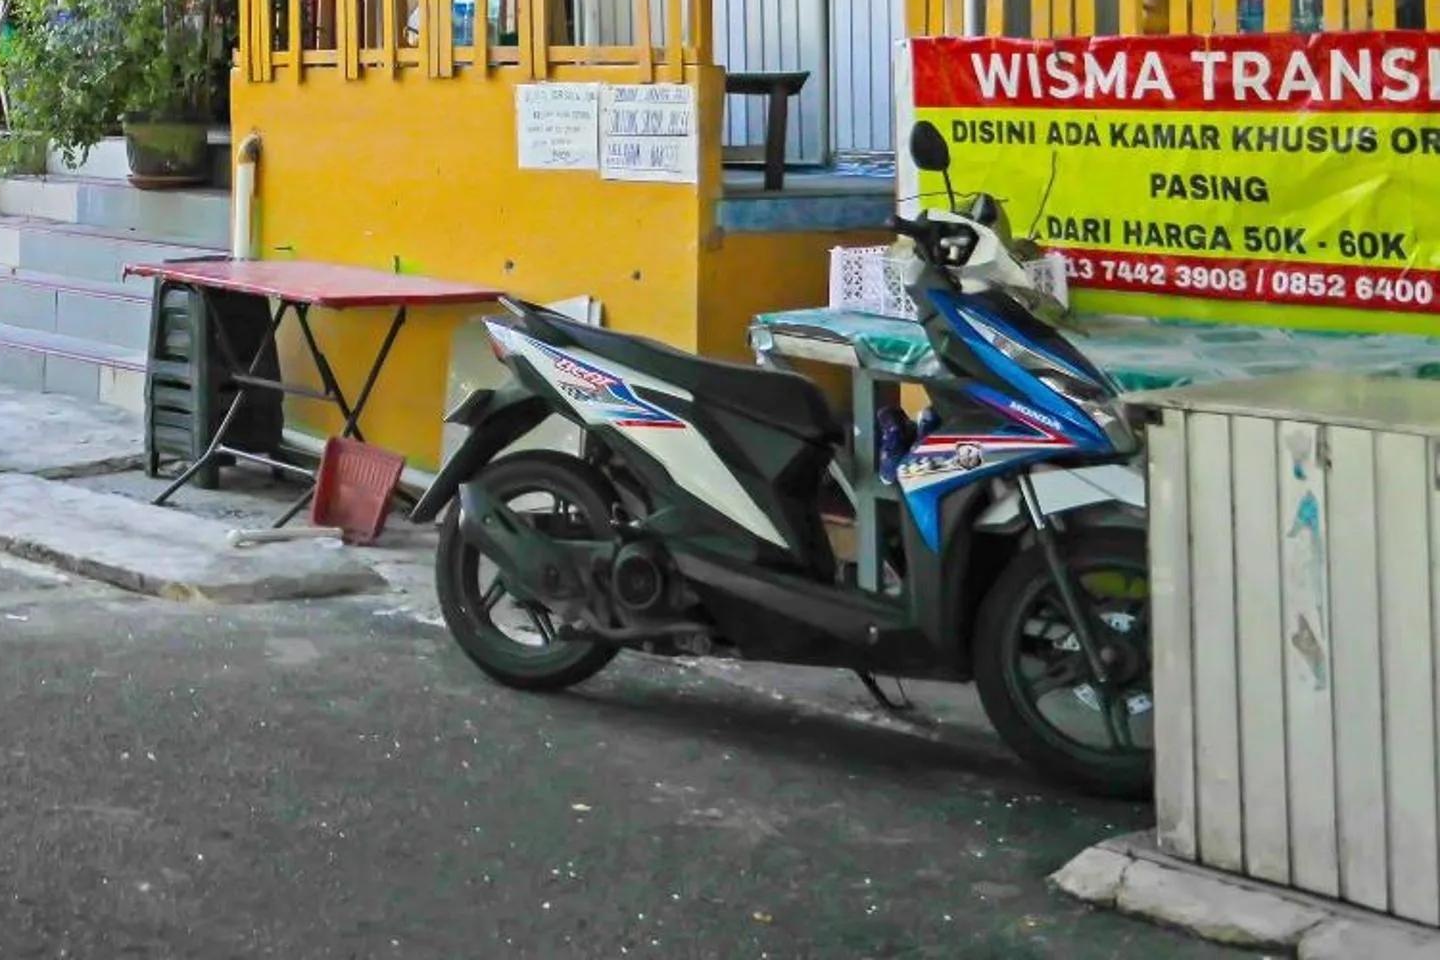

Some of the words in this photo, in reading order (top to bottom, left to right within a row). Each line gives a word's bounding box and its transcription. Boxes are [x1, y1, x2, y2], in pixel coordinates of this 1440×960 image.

[970, 51, 1176, 100] WISMA
[951, 120, 1036, 144] DISINI
[1046, 122, 1101, 147] ADA
[1110, 123, 1221, 150] KAMAR
[1232, 125, 1378, 153] KHUSUS
[1149, 173, 1269, 202] PASING
[1046, 216, 1111, 244] DARI
[1123, 220, 1232, 252] HARGA
[1243, 226, 1307, 255] 50K
[1338, 229, 1408, 261] 60K
[1100, 260, 1167, 286] 7442
[1174, 265, 1247, 291] 3908
[1272, 271, 1347, 298] 0852
[1354, 276, 1434, 305] 6400
